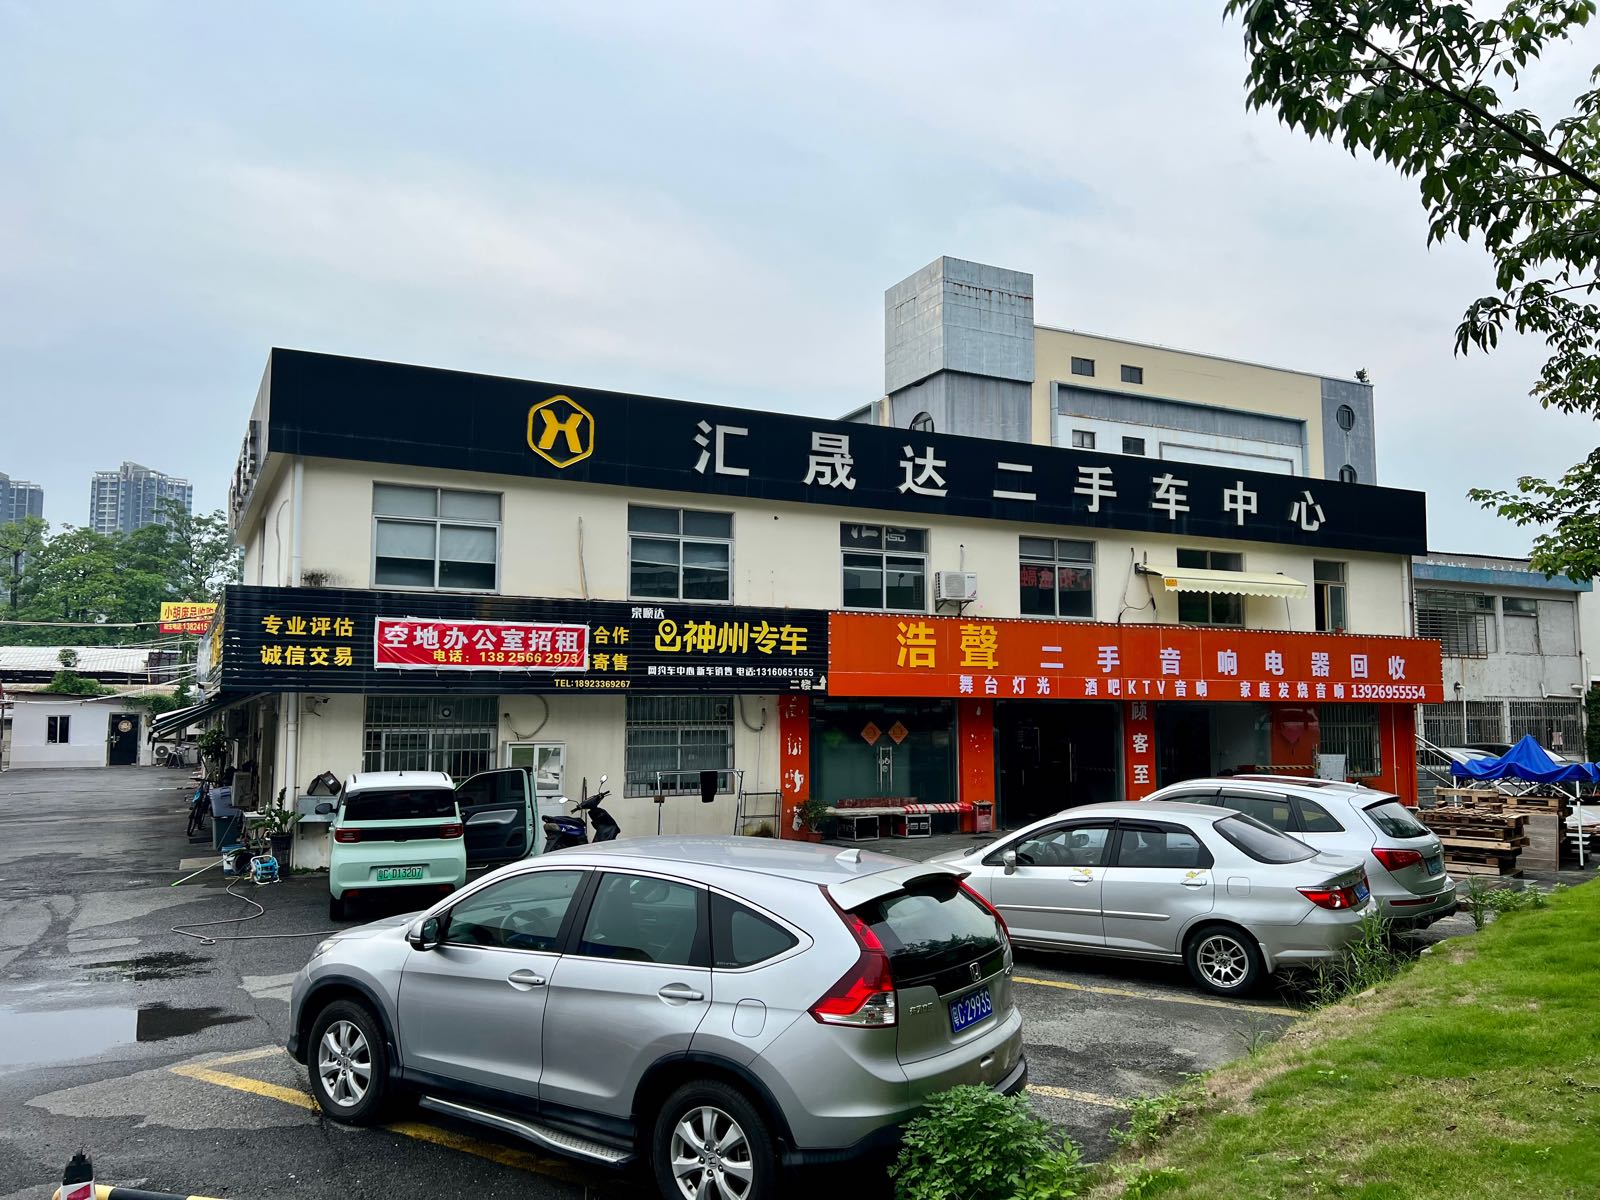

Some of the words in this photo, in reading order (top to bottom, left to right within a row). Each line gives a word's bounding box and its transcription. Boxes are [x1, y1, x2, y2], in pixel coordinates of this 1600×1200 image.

[694, 420, 1326, 532] 汇晟达二手车中心
[261, 614, 355, 637] 专业评估
[593, 626, 630, 645] 合作
[383, 625, 579, 653] 空地办公室招租
[683, 620, 808, 655] 神州专车
[260, 645, 354, 667] 诚信交易
[479, 651, 505, 662] 138
[508, 652, 542, 663] 2566
[545, 652, 579, 663] 2973
[896, 621, 999, 670] 浩聲
[1040, 645, 1406, 680] 二手音响电器回收
[592, 653, 629, 671] 寄售
[789, 679, 812, 691] 二楼
[959, 675, 1050, 695] 舞台灯光
[1131, 702, 1150, 798] 顾客至
